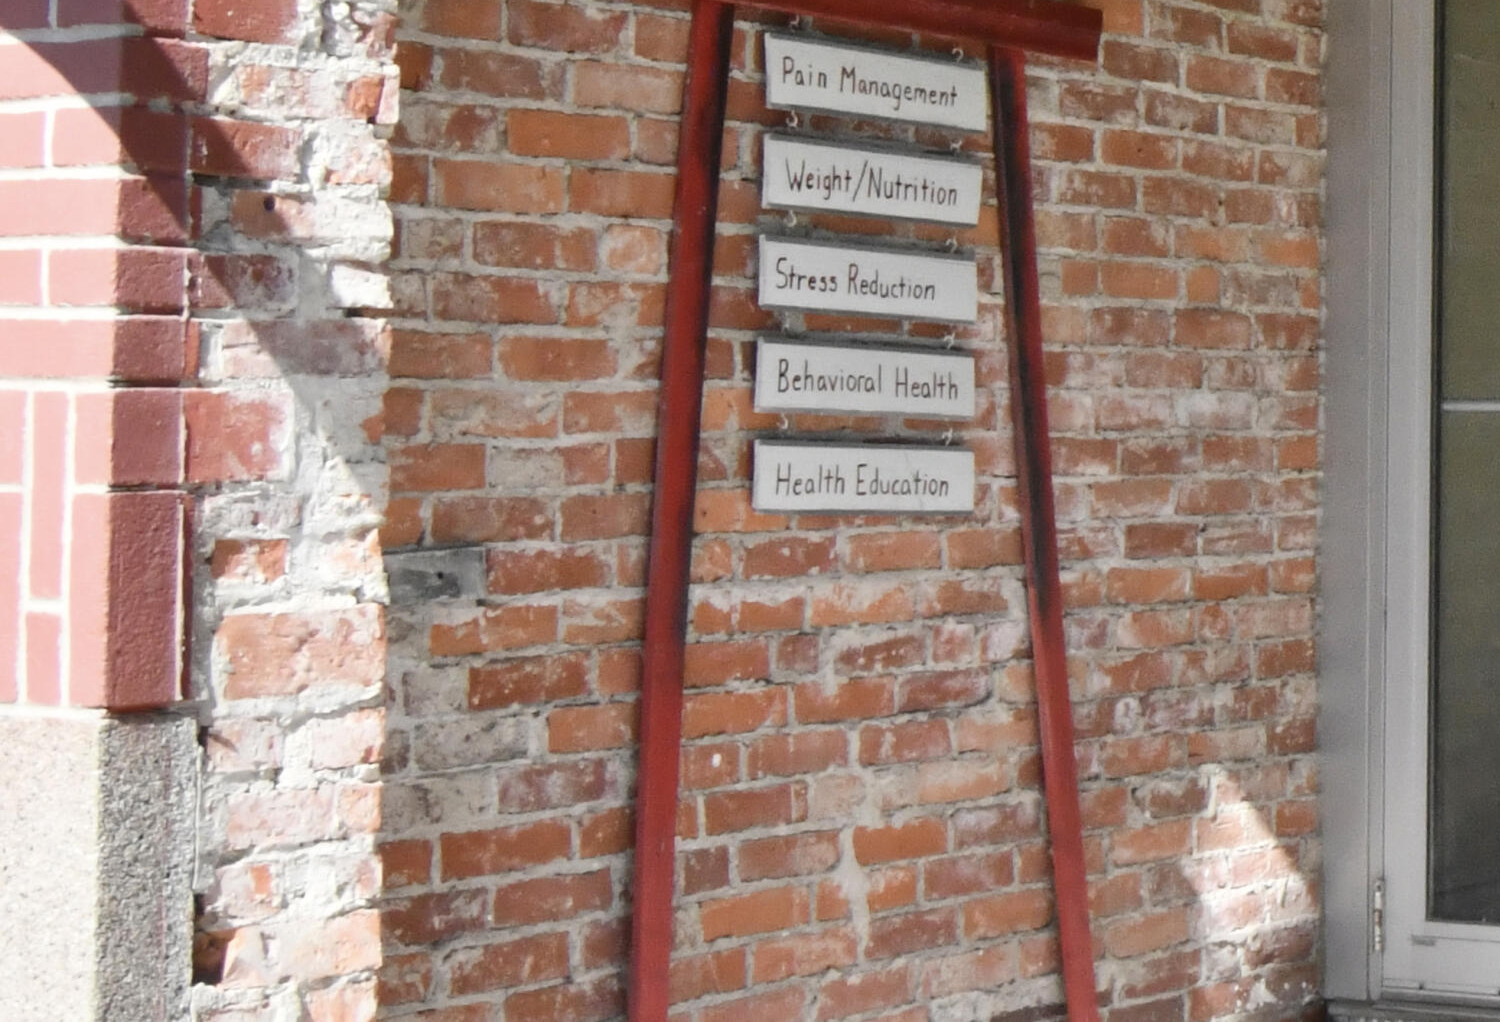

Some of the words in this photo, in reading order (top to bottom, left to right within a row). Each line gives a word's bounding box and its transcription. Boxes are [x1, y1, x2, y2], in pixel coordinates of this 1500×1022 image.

[781, 55, 829, 89] Pain
[840, 66, 959, 111] Management
[784, 157, 959, 208] Weight/Nutrition
[774, 256, 839, 294] Stress
[847, 263, 937, 303] Reduction
[777, 357, 883, 396] Behavioral
[894, 365, 960, 401] Health
[775, 462, 846, 498] Health
[856, 463, 951, 499] Education
